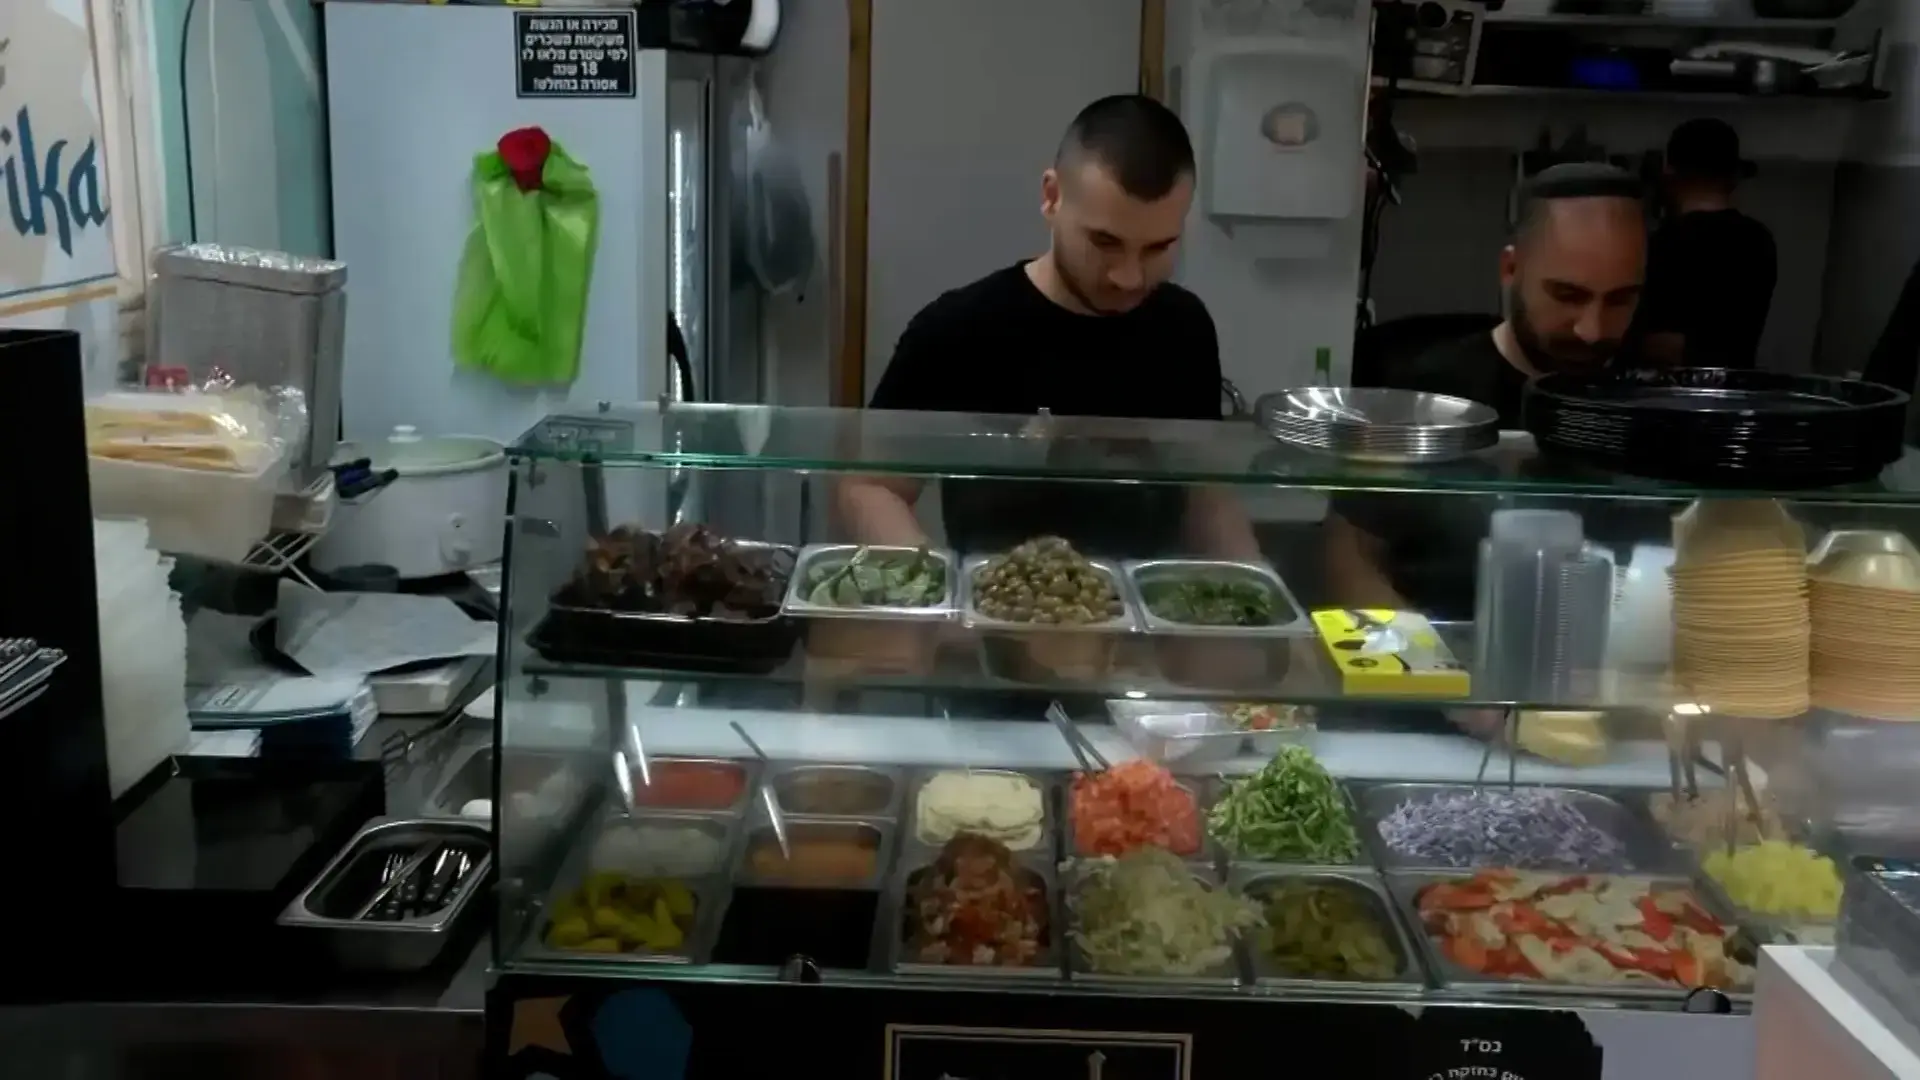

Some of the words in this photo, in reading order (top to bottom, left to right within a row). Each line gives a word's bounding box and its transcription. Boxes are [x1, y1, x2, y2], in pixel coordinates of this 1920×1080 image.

[566, 19, 580, 31] או
[582, 19, 618, 31] מכירה
[525, 34, 572, 46] משכרים
[574, 34, 625, 47] משקאות
[522, 48, 534, 61] לו
[537, 48, 566, 61] מלאו
[569, 49, 604, 61] שטרם
[553, 63, 577, 76] שנה
[580, 61, 598, 76] 18
[580, 79, 618, 91] אסורה
[0, 104, 109, 258] ika
